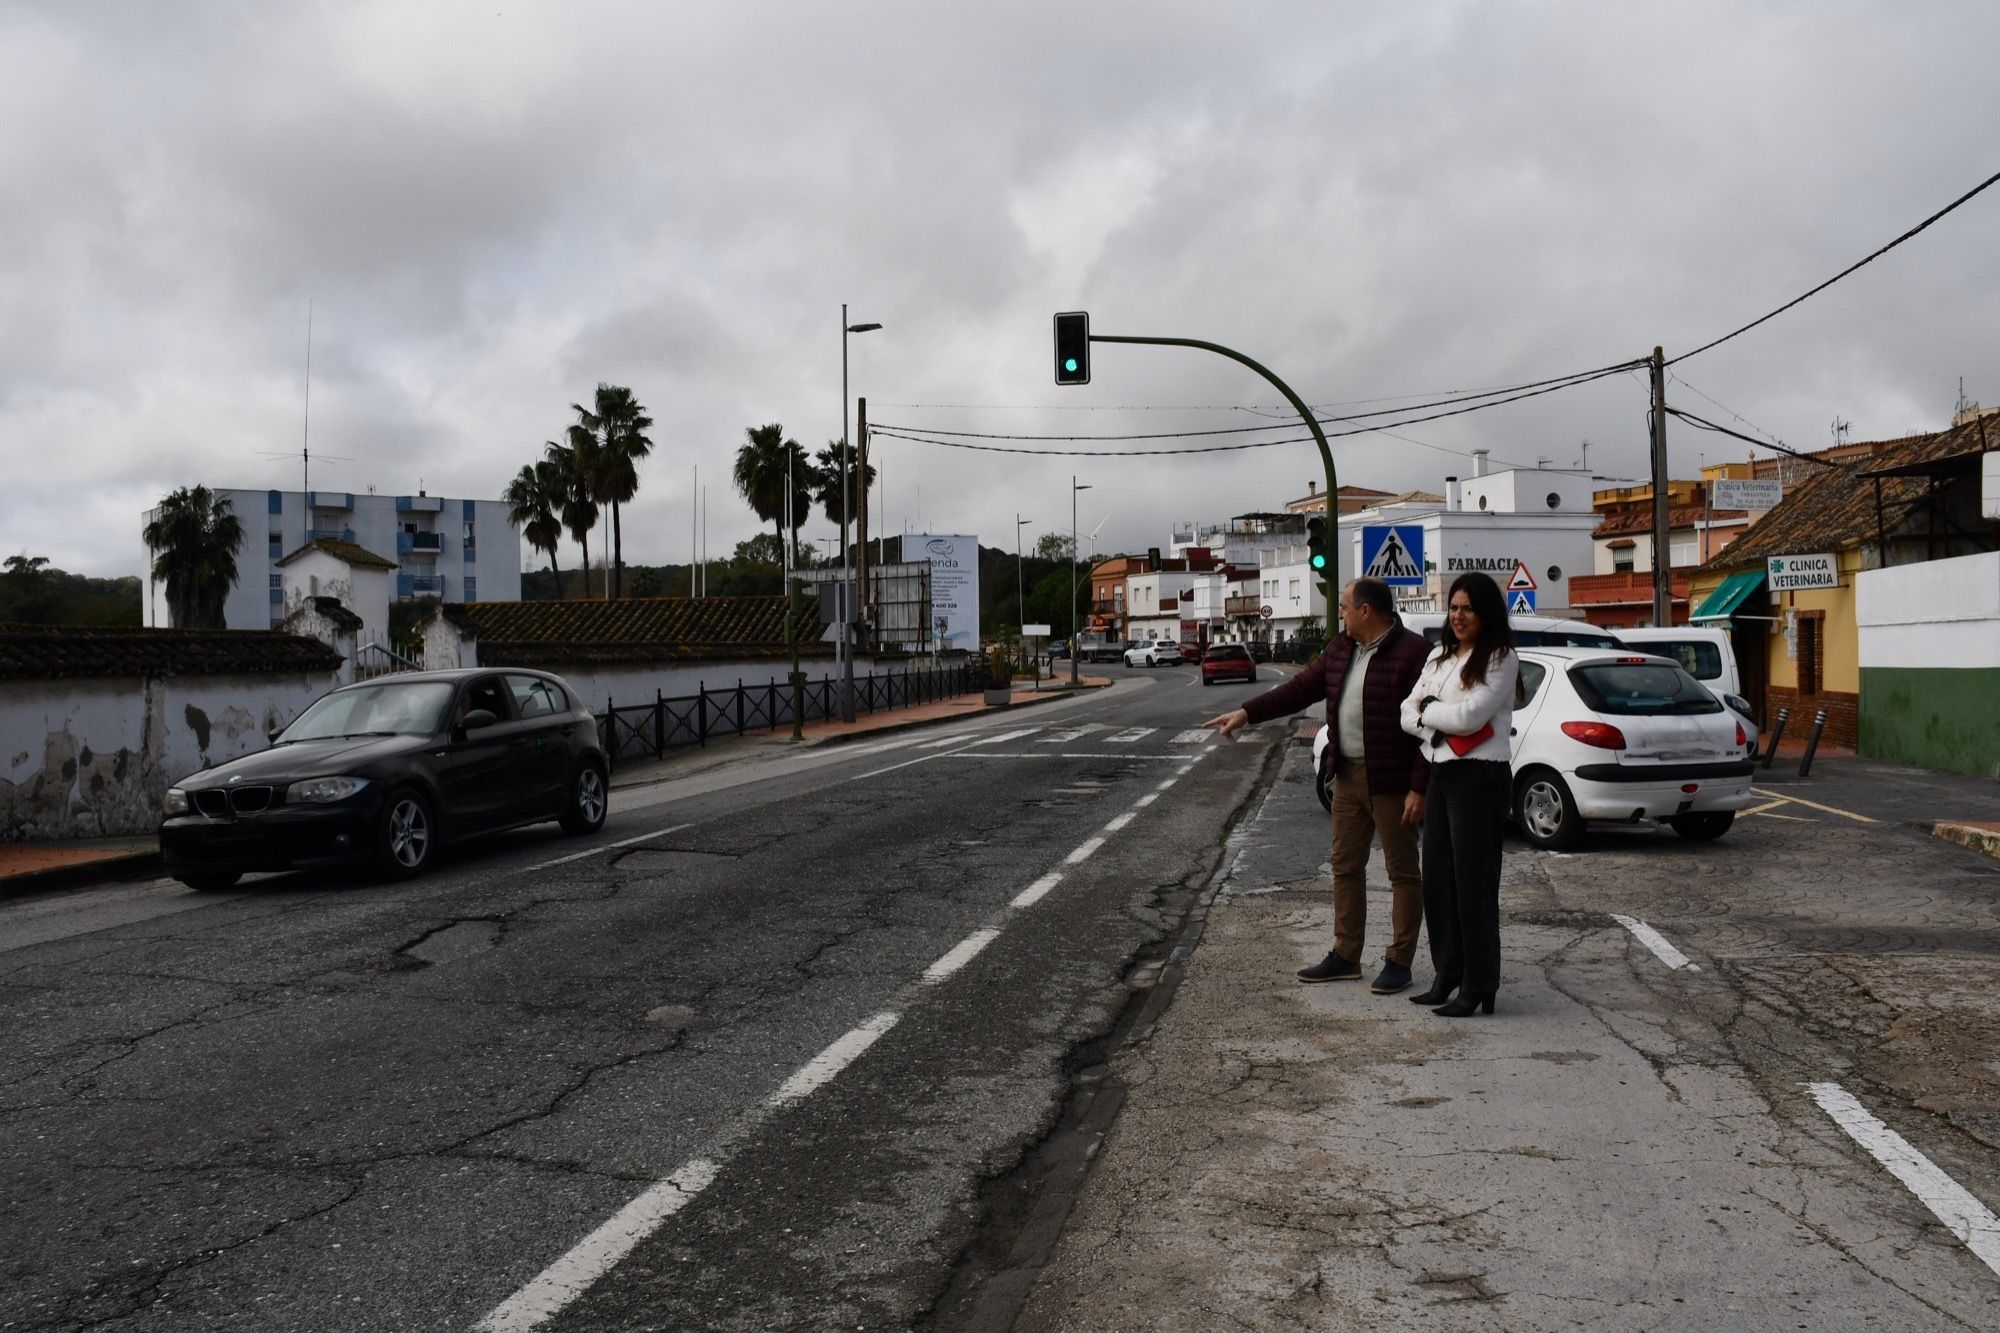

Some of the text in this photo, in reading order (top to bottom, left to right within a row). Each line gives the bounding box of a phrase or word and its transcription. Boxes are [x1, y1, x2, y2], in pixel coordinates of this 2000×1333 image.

[931, 559, 959, 568] enda
[1447, 558, 1519, 571] FARMACIA
[1790, 560, 1828, 572] CLINICA
[1774, 574, 1833, 587] VETERINARIA
